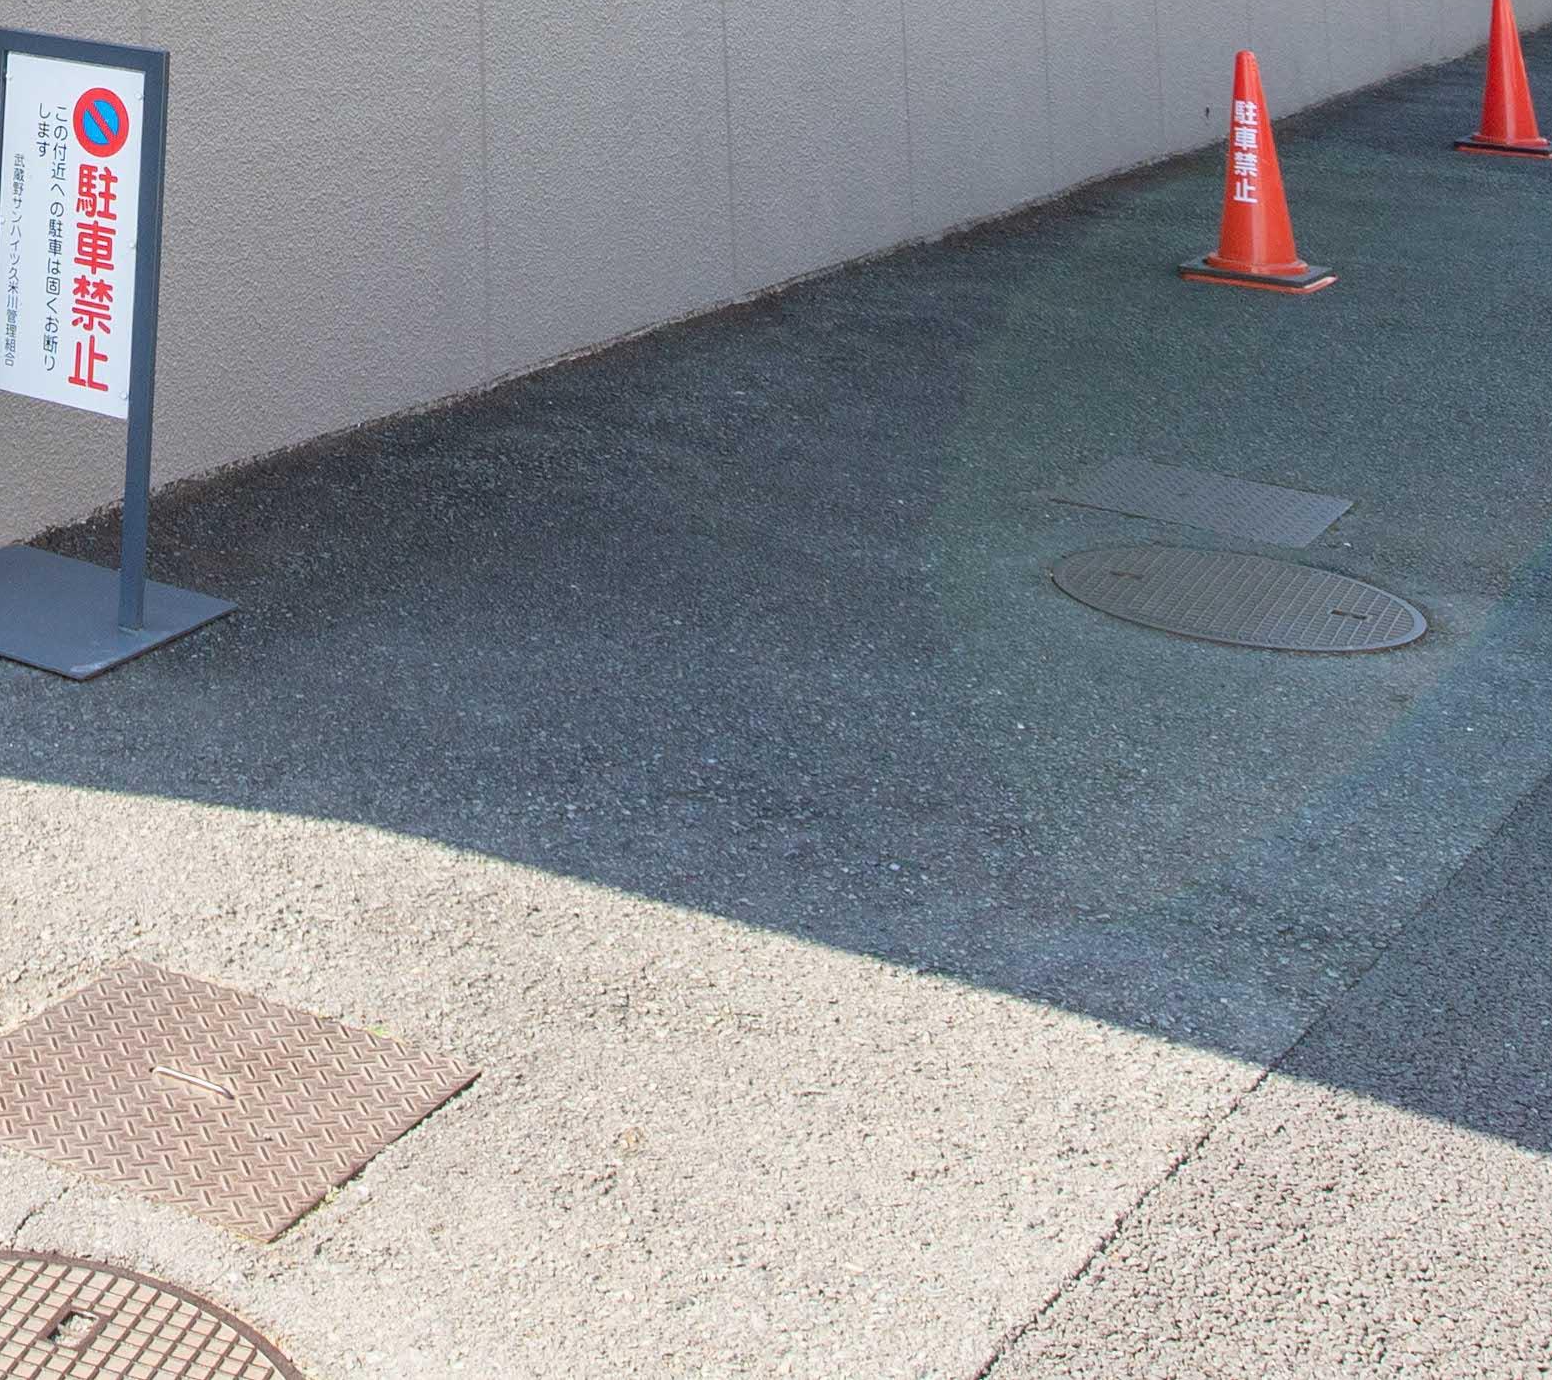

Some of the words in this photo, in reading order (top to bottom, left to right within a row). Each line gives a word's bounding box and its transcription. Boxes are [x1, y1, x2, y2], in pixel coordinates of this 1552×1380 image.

[36, 102, 52, 157] します
[1234, 100, 1258, 204] 駐車禁止
[4, 153, 25, 367] 武蔵野サンハイツ久米川管理組合
[43, 106, 68, 371] この付近への駐車は固くお断り
[68, 163, 118, 392] 駐車禁止
